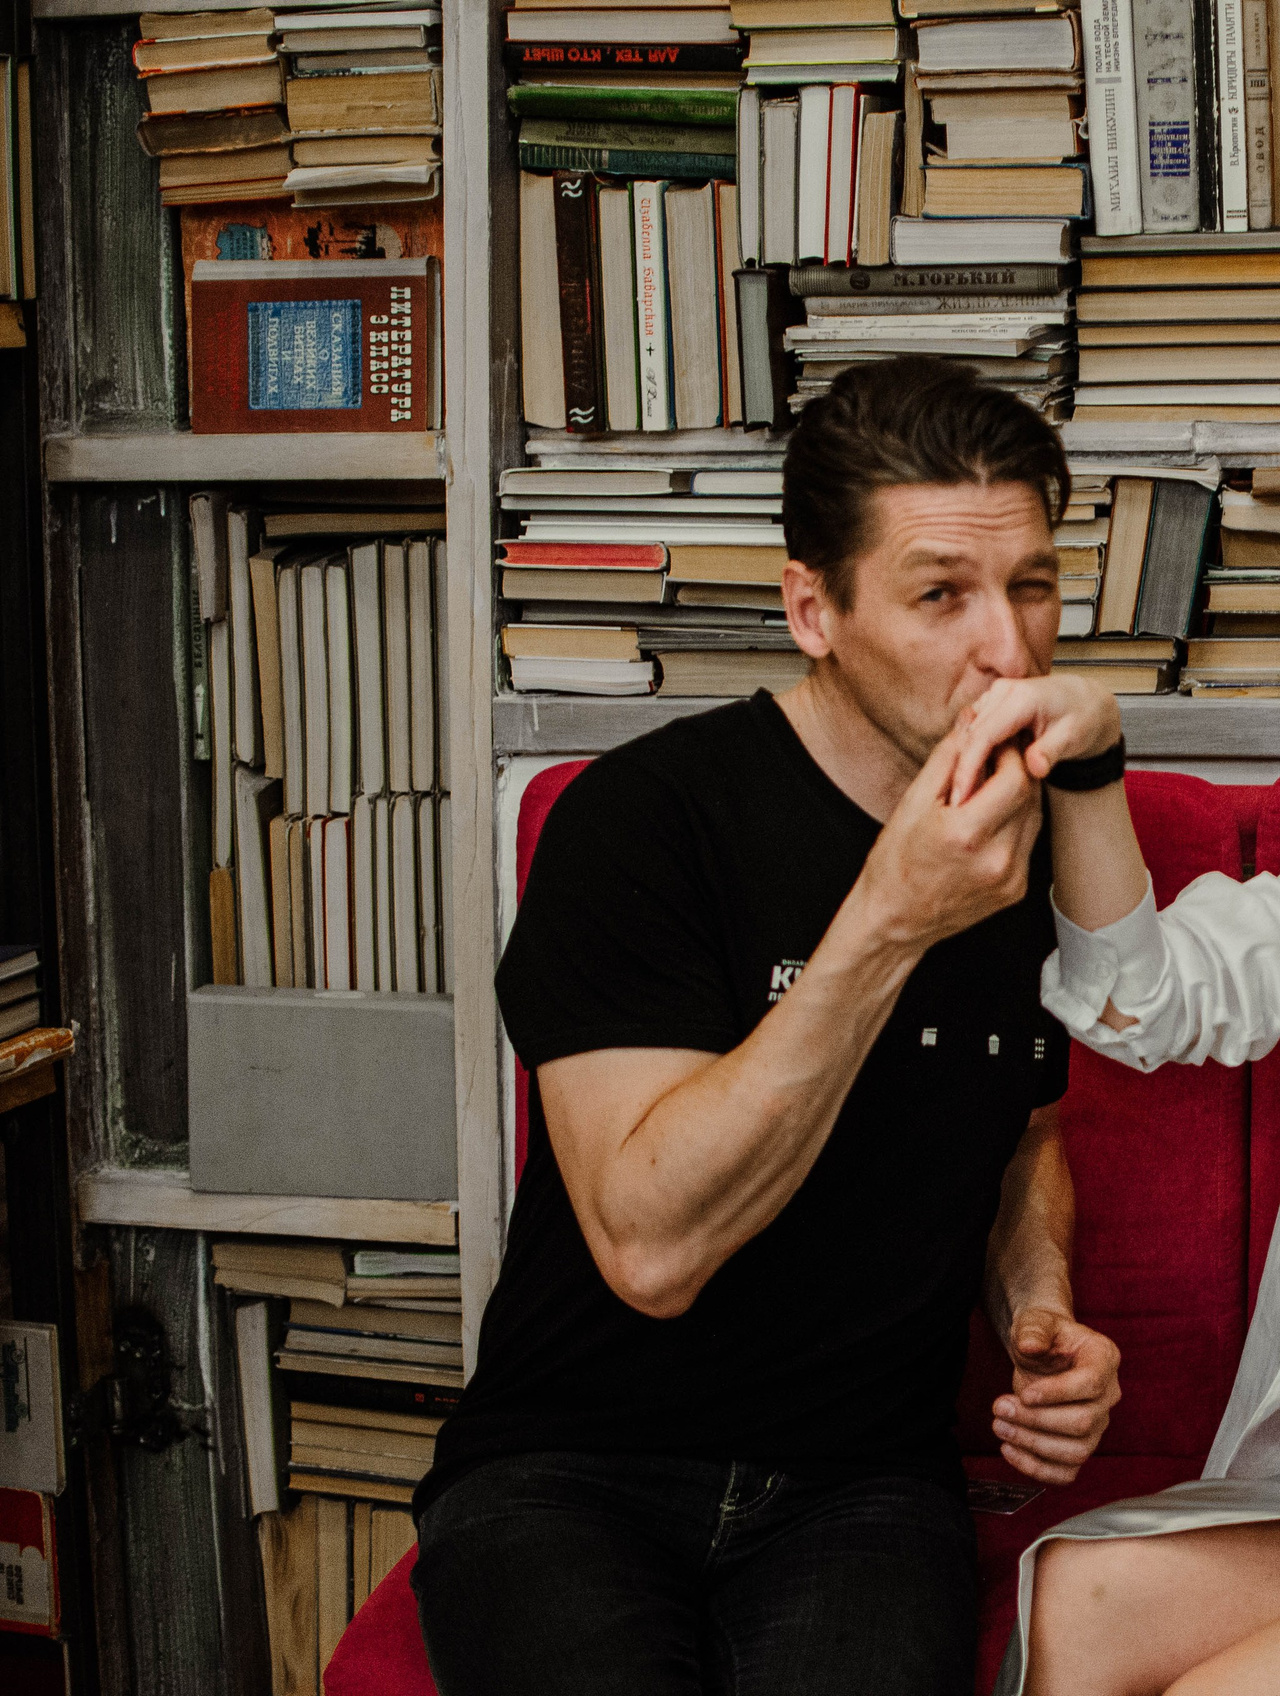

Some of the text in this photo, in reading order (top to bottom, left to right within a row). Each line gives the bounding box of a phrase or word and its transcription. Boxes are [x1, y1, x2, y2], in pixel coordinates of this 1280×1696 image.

[523, 48, 564, 62] ШЬЕТ
[568, 48, 600, 62] КТО
[648, 47, 679, 62] ДЛЯ
[1094, 18, 1103, 74] ПОЛАЯ ВОДА
[1102, 25, 1111, 59] ТЕСНОЙ
[1104, 60, 1112, 73] НА
[1112, 41, 1120, 73] ЖИЗНЬ
[1225, 3, 1239, 100] КОРИДОРЫ ПАМЯТИ
[1104, 88, 1121, 212] МИХАИЛ НИКУЛИН
[640, 267, 657, 336] Баварская
[267, 317, 279, 395] ПОДВИГАХ
[282, 350, 292, 360] И
[293, 326, 304, 384] БИТВАХ
[305, 320, 316, 390] ВЕЛИКИХ
[319, 349, 329, 360] О
[331, 312, 342, 396] СКАЗАНИЯ
[369, 315, 389, 393] 3 КЛАСС
[391, 287, 411, 423] ЛИТЕРАТУРА
